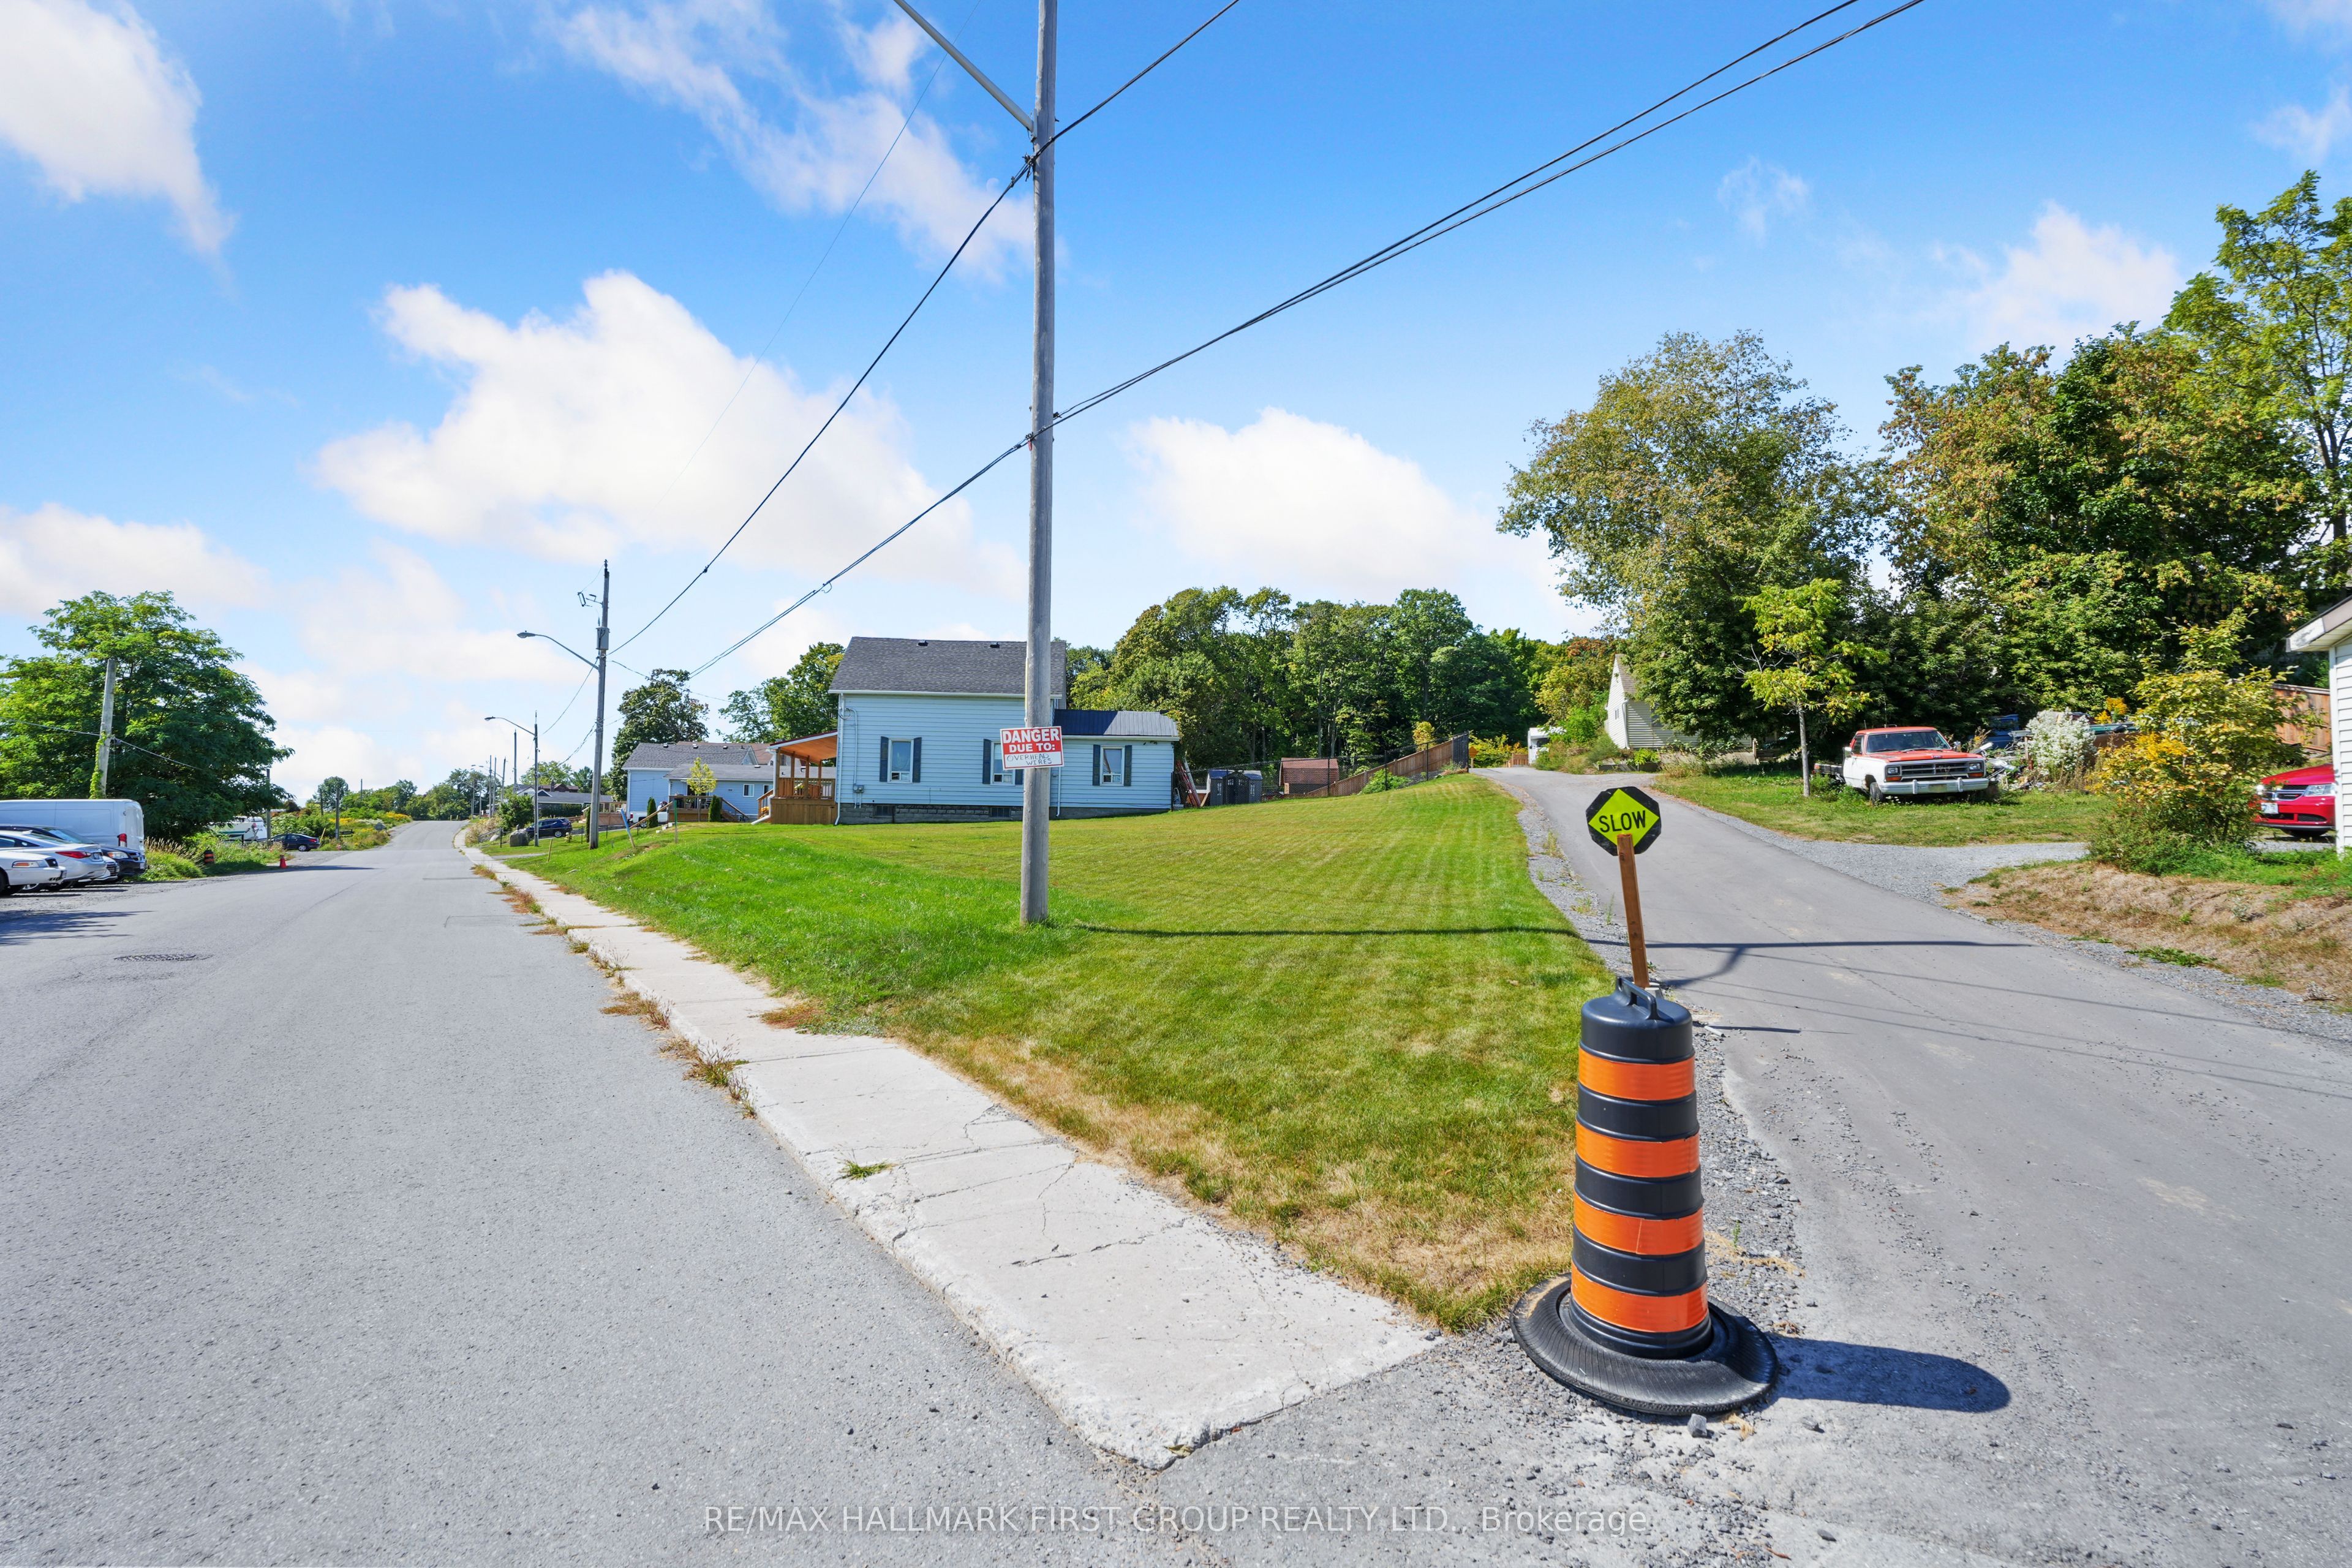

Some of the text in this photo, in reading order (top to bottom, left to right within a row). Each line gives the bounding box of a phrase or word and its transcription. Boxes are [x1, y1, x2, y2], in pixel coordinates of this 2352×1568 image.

[1003, 728, 1060, 743] DANGER
[1009, 742, 1055, 752] DUE TO:
[1599, 810, 1646, 832] SLOW
